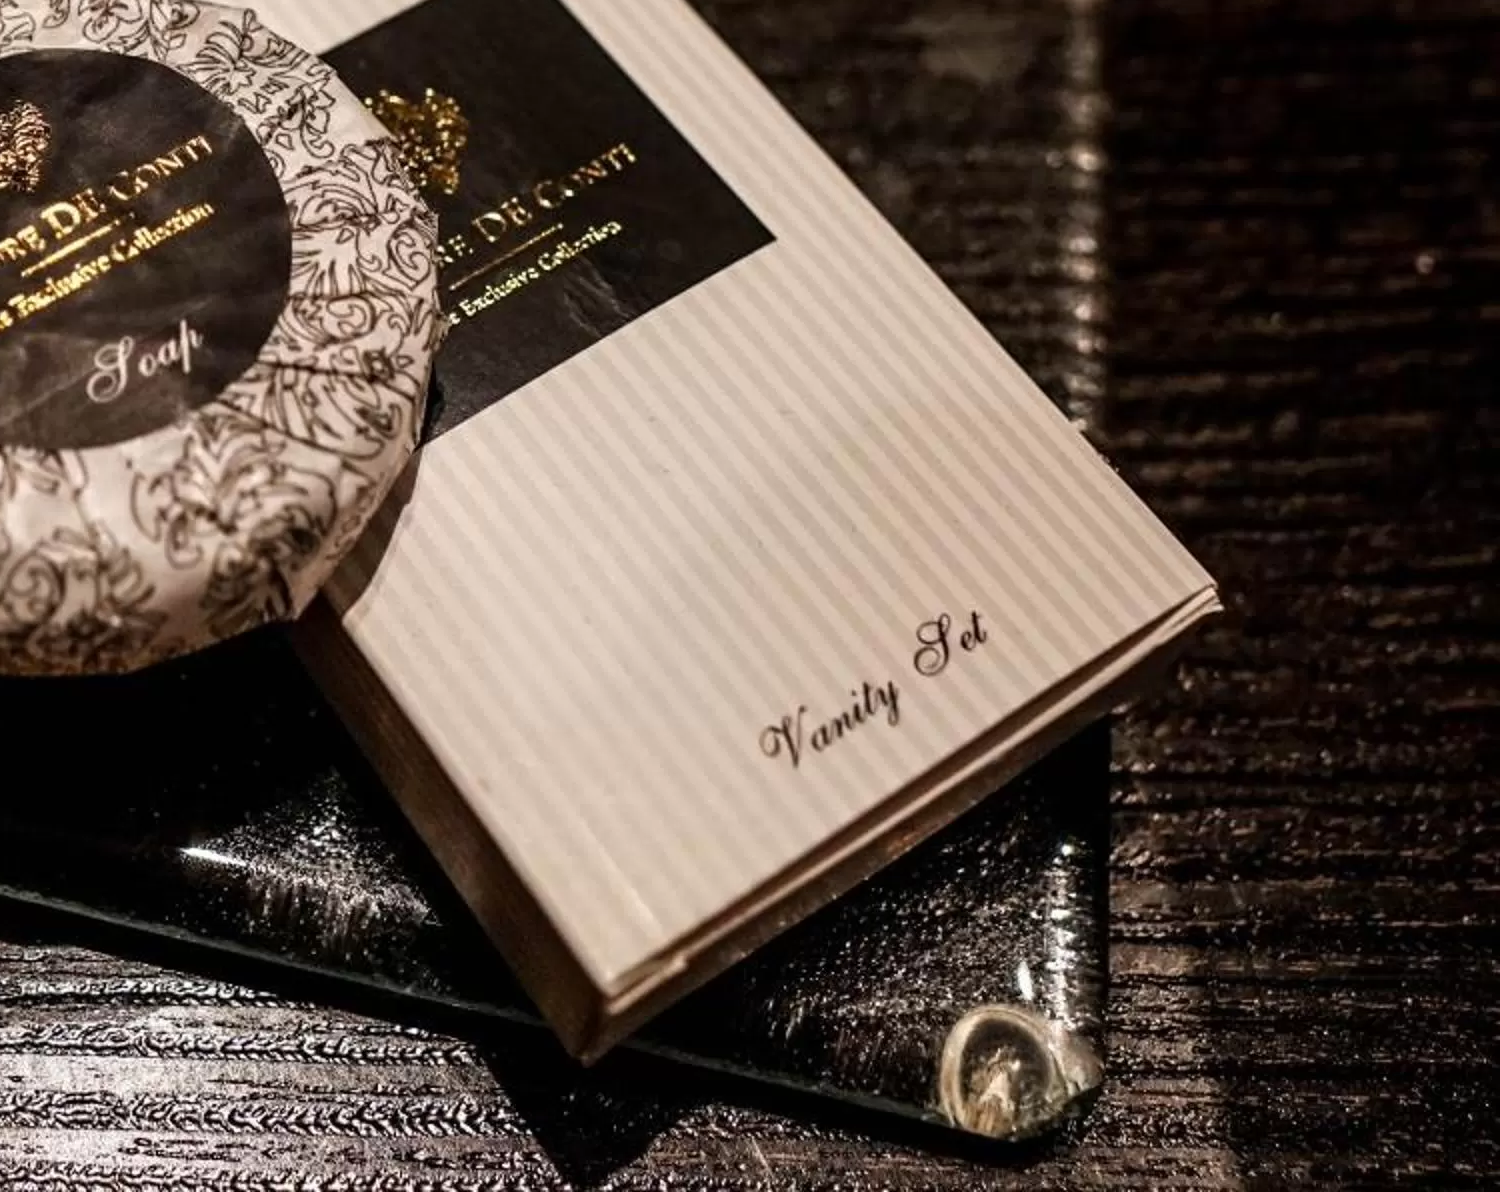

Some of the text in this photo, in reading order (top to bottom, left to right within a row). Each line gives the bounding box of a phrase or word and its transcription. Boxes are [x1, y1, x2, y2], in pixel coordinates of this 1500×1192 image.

[40, 187, 107, 240] DE
[108, 134, 213, 202] CONTI
[471, 143, 638, 243] DE CONTI
[8, 254, 113, 316] Exclusive
[110, 202, 215, 264] Collection
[458, 265, 540, 319] Exclusive
[537, 220, 623, 271] Collection
[85, 318, 204, 404] Soap
[758, 610, 988, 769] Vanity Set
